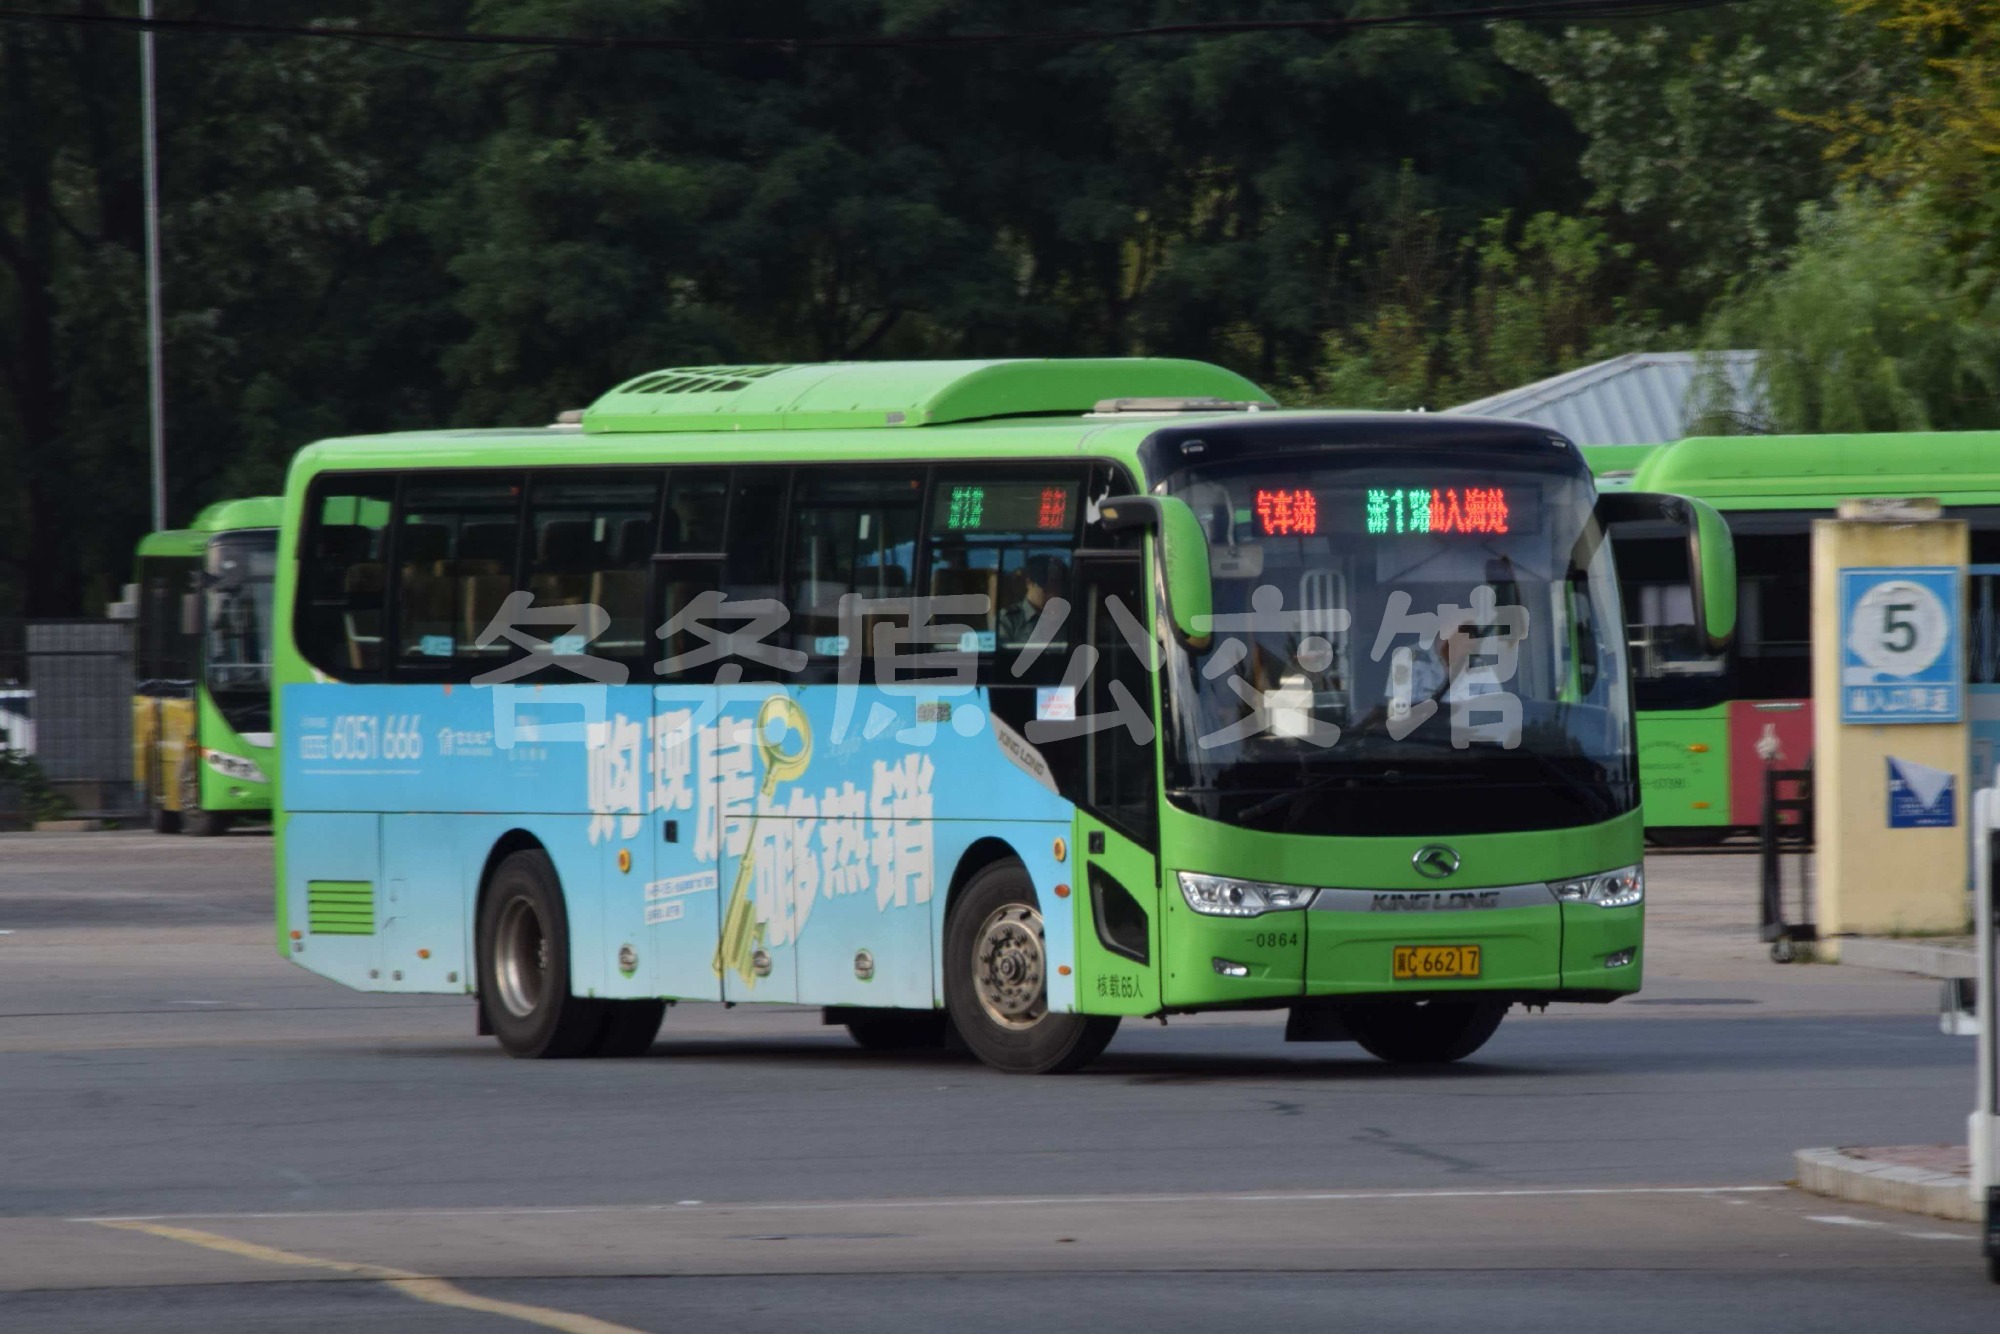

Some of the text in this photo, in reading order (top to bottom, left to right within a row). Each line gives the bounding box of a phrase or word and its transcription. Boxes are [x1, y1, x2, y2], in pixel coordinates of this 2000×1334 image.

[1882, 603, 1919, 654] 5
[331, 715, 378, 760] 6051
[383, 714, 423, 760] 666
[1019, 748, 1045, 777] LONG
[1370, 891, 1500, 912] KING LONG
